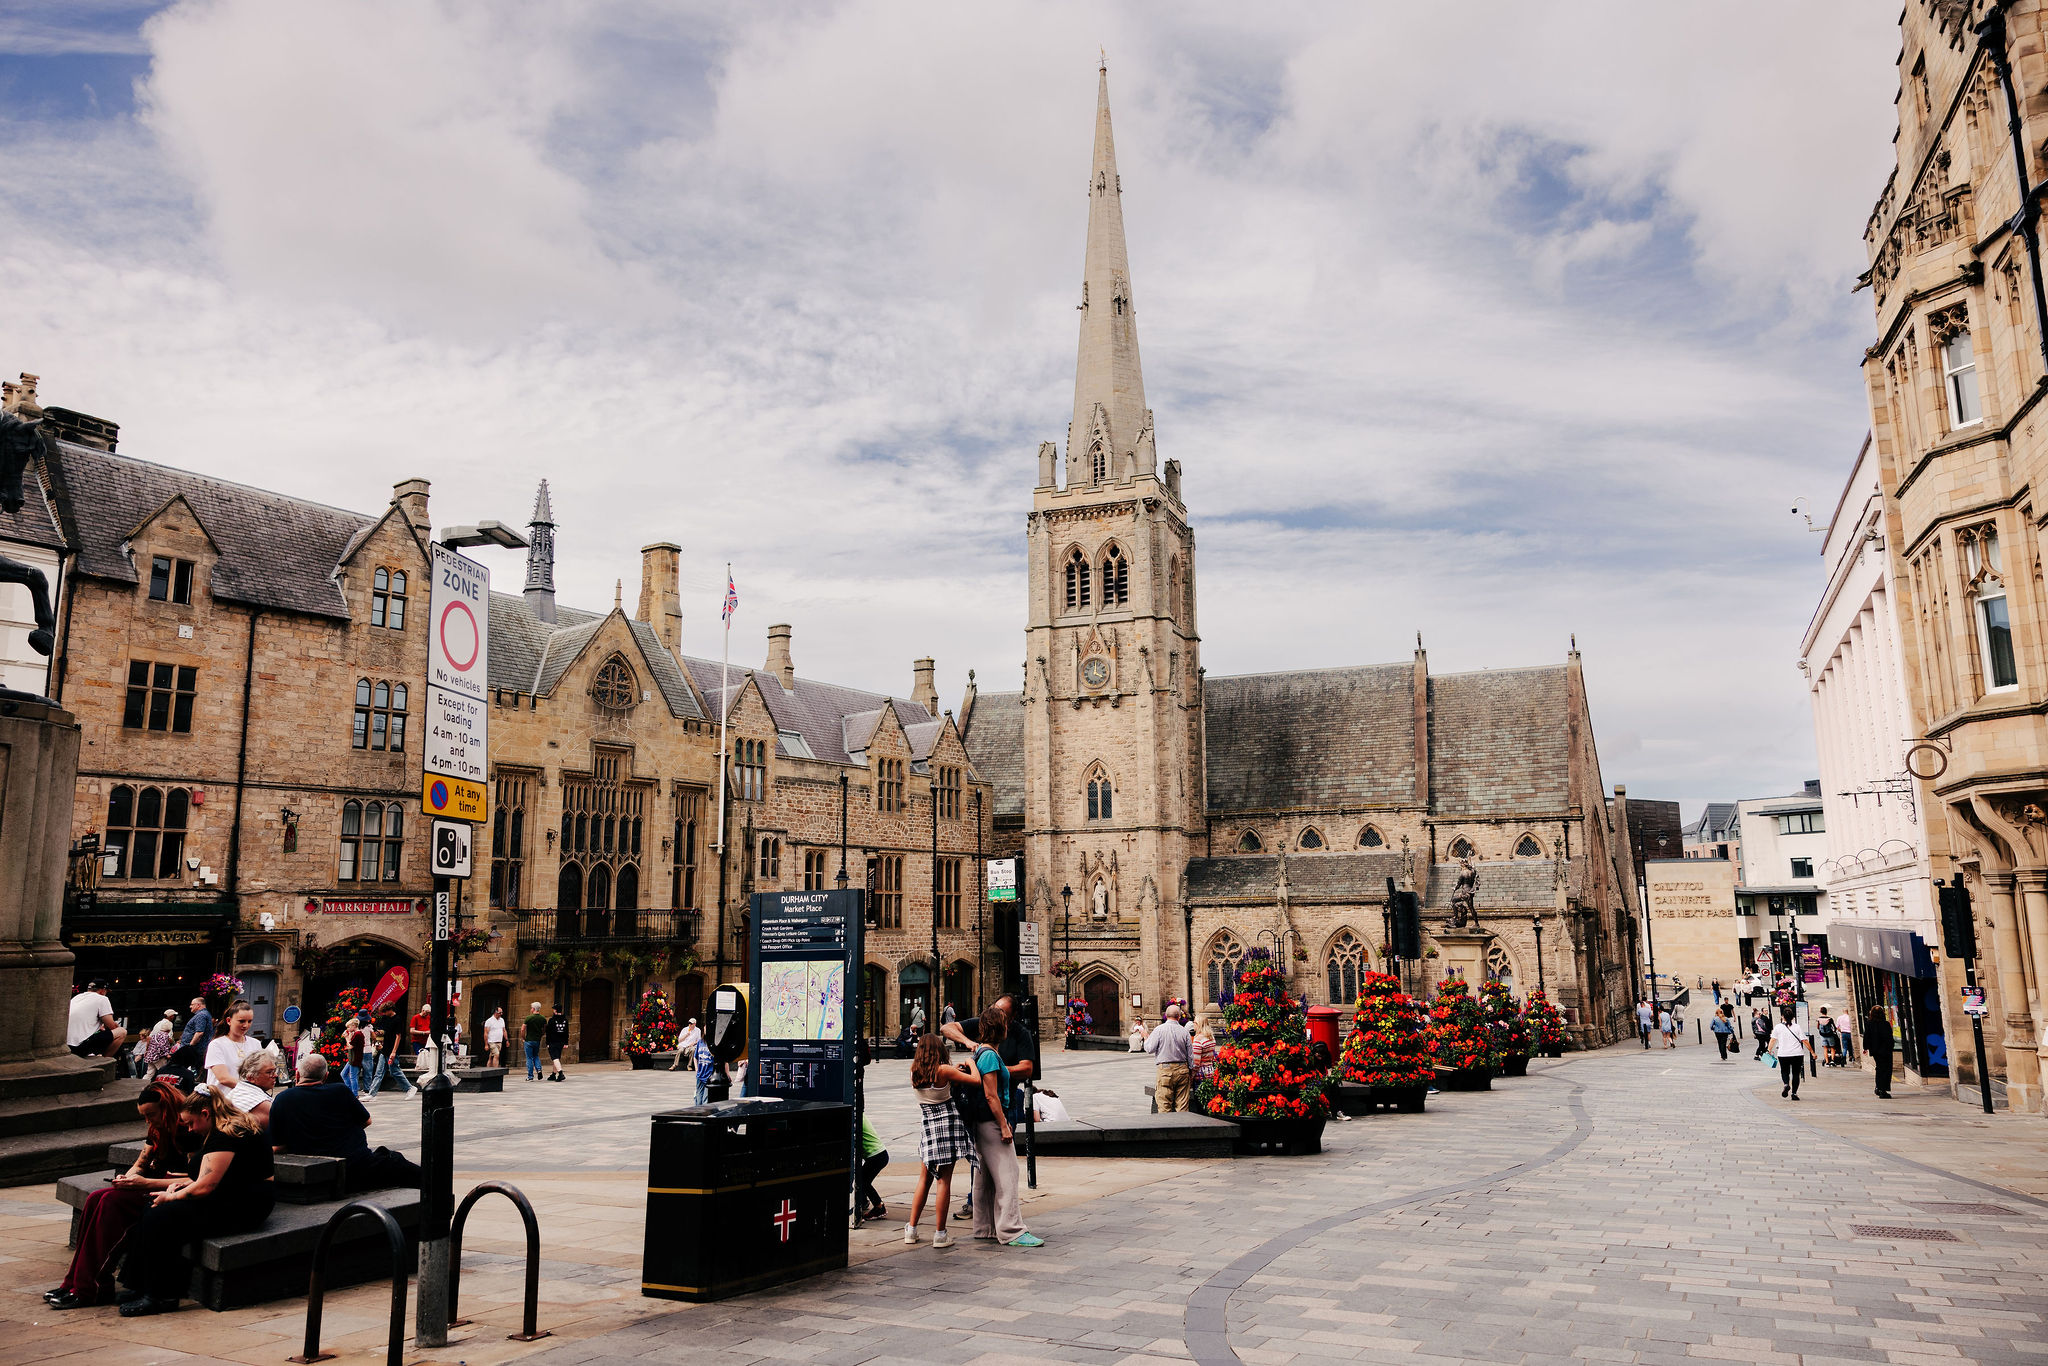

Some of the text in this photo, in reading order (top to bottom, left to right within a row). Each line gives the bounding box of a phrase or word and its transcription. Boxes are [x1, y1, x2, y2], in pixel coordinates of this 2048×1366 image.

[435, 549, 486, 582] PEDESTRIAN
[443, 568, 479, 601] ZONE
[436, 668, 480, 693] No vehicles
[438, 693, 478, 716] Except for
[443, 710, 472, 729] loading
[433, 726, 439, 736] 4
[441, 729, 453, 740] am
[458, 732, 468, 743] 10
[469, 737, 480, 747] am
[450, 746, 465, 757] and
[431, 755, 437, 766] 4
[439, 759, 452, 769] pm
[458, 760, 467, 772] 10
[469, 764, 480, 775] pm
[455, 785, 481, 801] At any
[458, 800, 477, 813] time
[1653, 882, 1704, 891] ONLY YOU
[781, 894, 826, 904] DURHAM CITY
[1654, 895, 1711, 905] CAN WRITE
[324, 902, 410, 912] MARKET HALL
[784, 904, 823, 913] Market Place
[1655, 908, 1734, 918] THE NEXT PAGE
[438, 893, 448, 939] 2330
[82, 931, 199, 944] MARKET TAVERN
